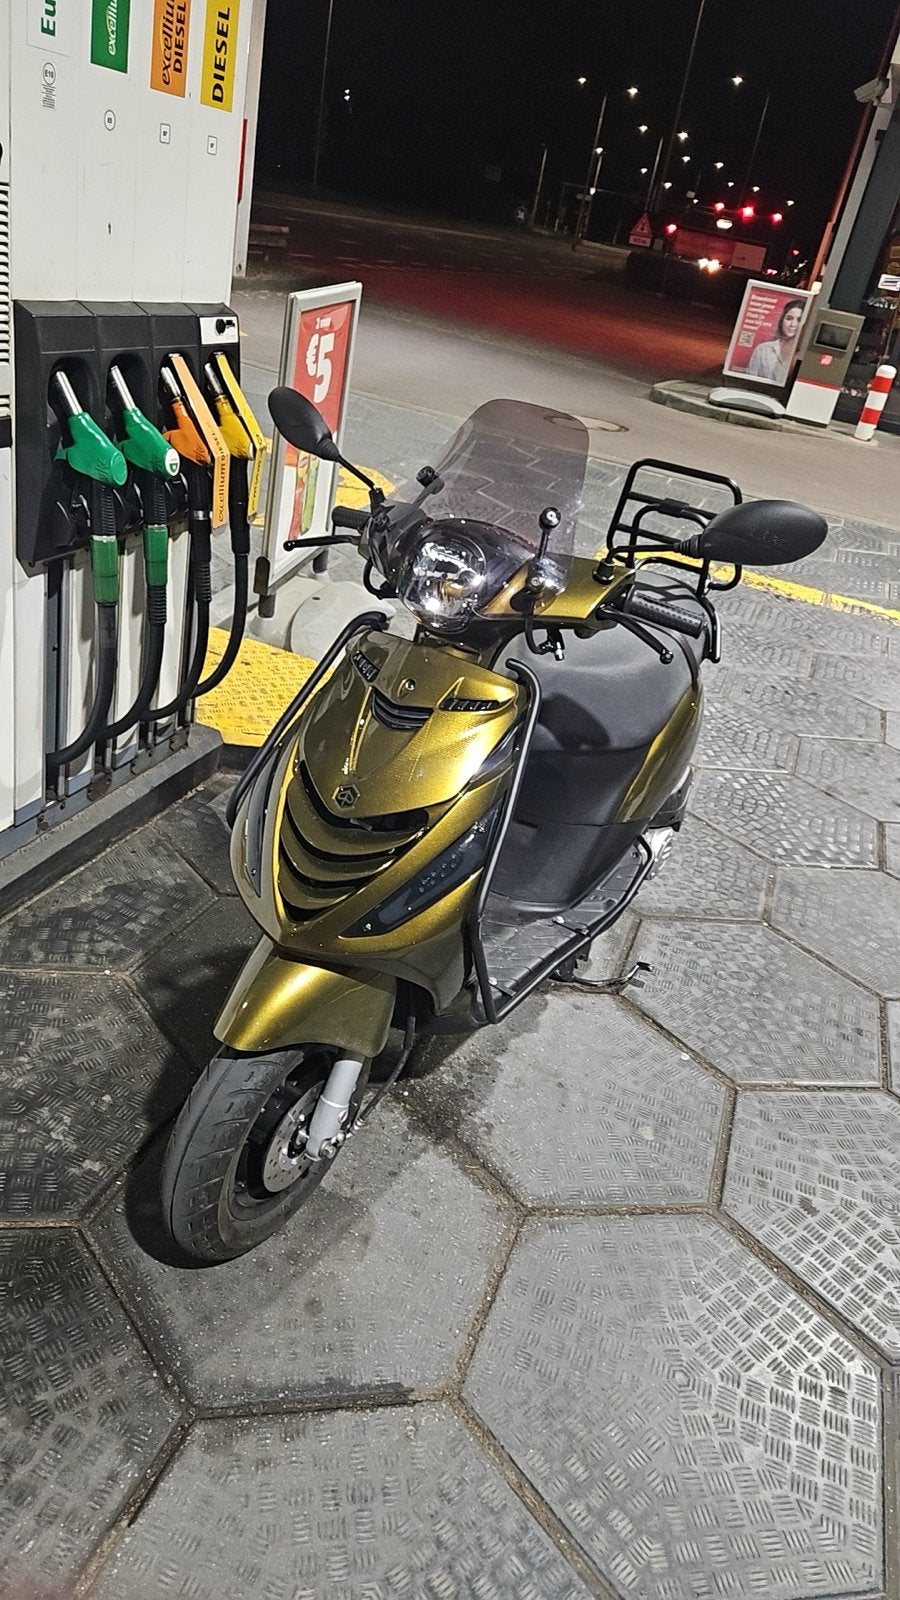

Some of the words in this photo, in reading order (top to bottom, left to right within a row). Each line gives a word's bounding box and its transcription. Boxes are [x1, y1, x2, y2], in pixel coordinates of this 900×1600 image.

[40, 0, 56, 37] Eu
[161, 0, 175, 86] excelliu
[173, 2, 187, 74] DIESEL
[212, 7, 230, 103] DIESEL
[306, 332, 335, 404] €5
[218, 463, 226, 523] excellium
